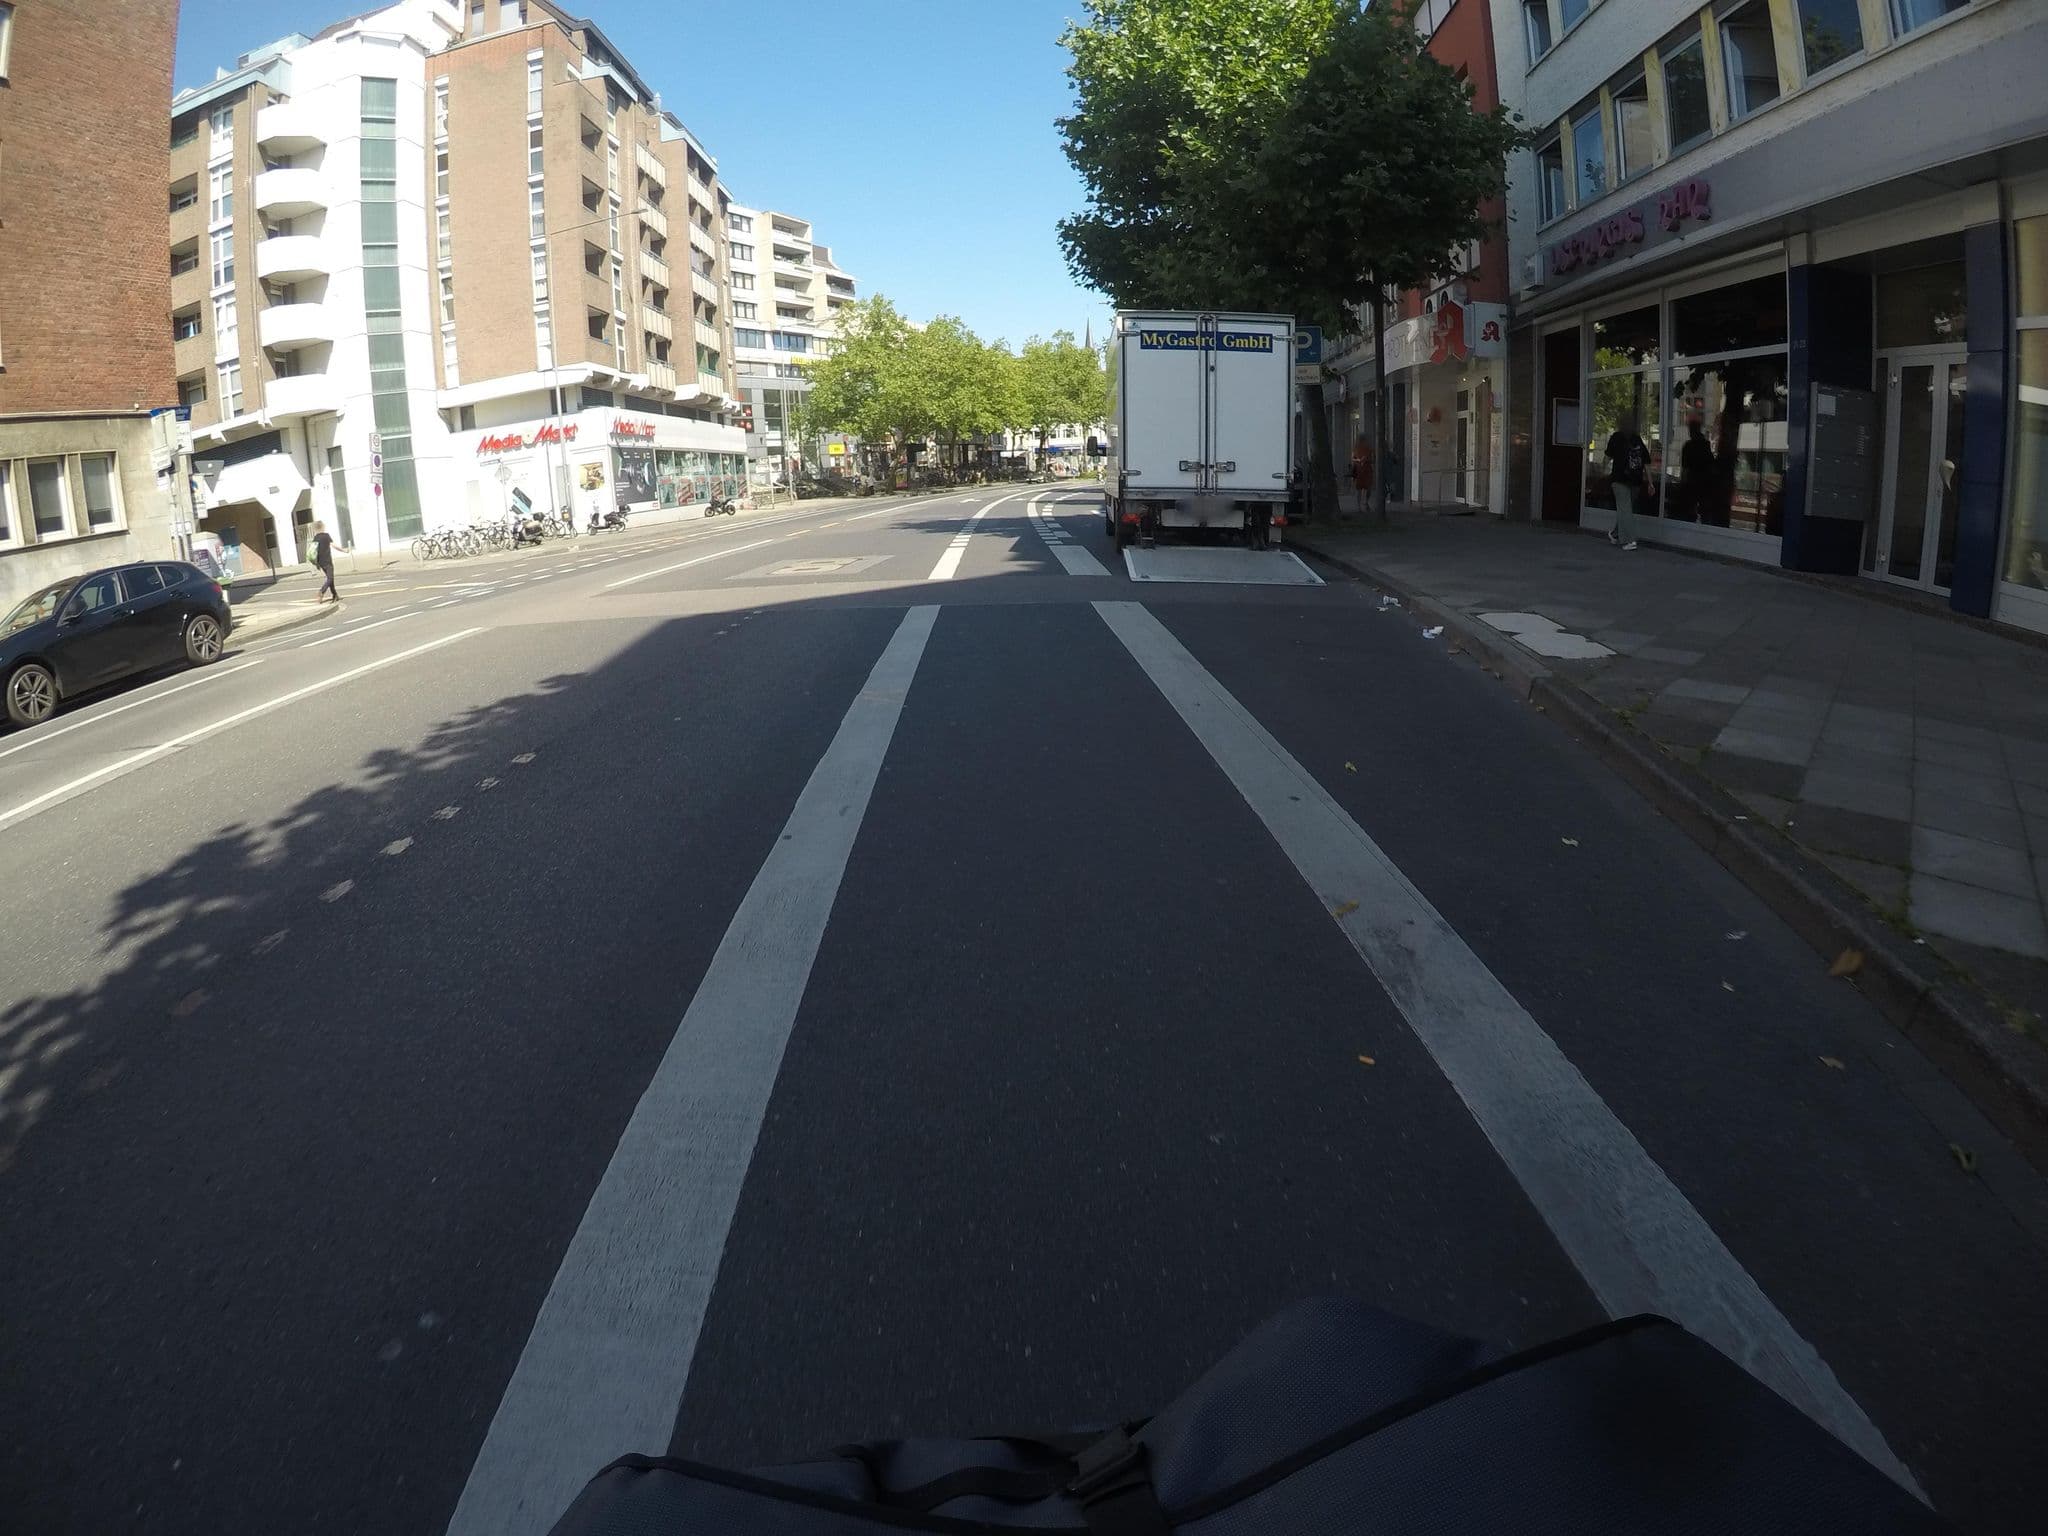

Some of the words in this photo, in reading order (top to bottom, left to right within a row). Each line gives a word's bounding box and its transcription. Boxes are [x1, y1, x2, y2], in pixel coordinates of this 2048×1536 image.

[1141, 332, 1217, 349] MyGastro
[1222, 333, 1271, 349] GmbH
[1295, 331, 1313, 360] P
[476, 434, 522, 455] Media
[533, 423, 578, 444] Makt
